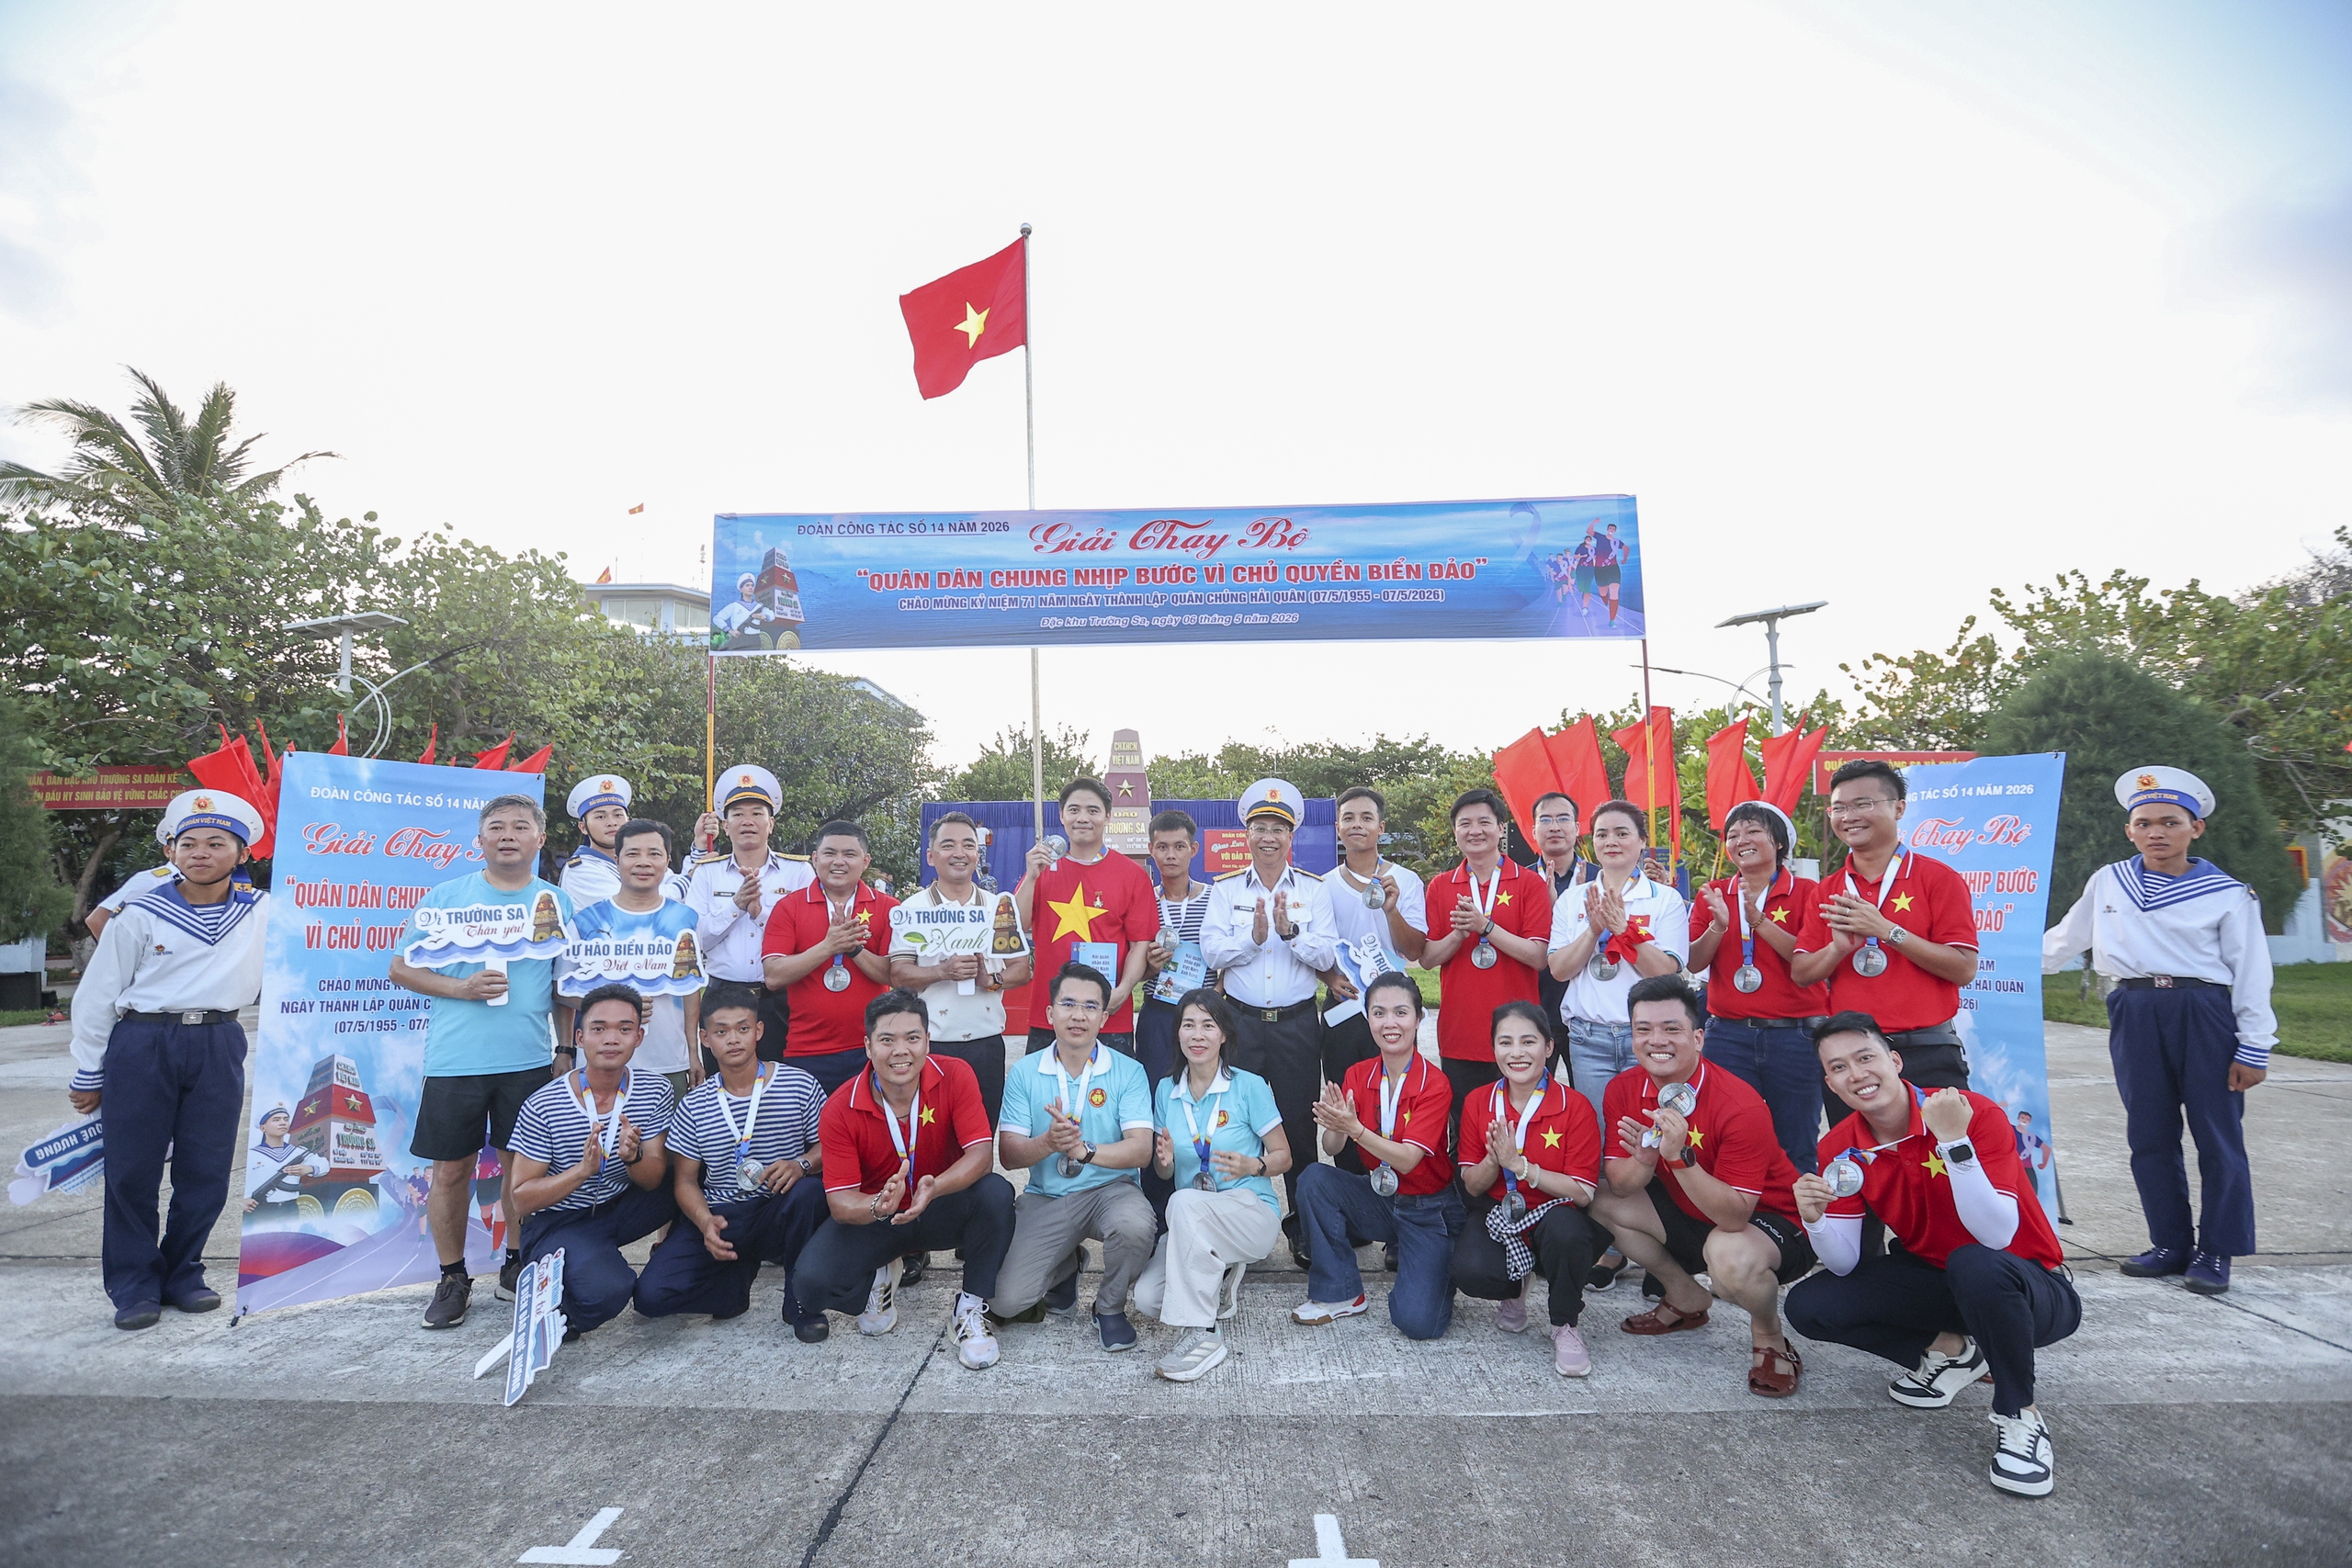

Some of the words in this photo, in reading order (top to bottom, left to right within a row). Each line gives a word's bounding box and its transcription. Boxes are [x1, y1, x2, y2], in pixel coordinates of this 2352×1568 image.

[797, 522, 833, 535] ĐOÀN
[838, 522, 874, 535] CÔNG
[878, 521, 904, 534] TÁC
[909, 519, 927, 533] SỐ
[931, 523, 944, 533] 14
[948, 521, 977, 533] NĂM
[980, 521, 1010, 533] 2026
[1029, 522, 1118, 554] Giải
[1128, 517, 1231, 561] Chạy
[1237, 516, 1309, 551] Bộ
[936, 568, 983, 589] DÂN
[989, 568, 1068, 588] CHUNG
[1073, 567, 1129, 589] NHỊP
[1136, 563, 1198, 586] BƯỚC
[1204, 561, 1226, 584] VÌ
[1232, 559, 1279, 583] CHỦ
[1285, 558, 1362, 582] QUYỀN
[1368, 558, 1423, 581] BIỂN
[899, 596, 930, 611] CHÀO
[933, 595, 967, 610] MỪNG
[970, 593, 986, 609] KỶ
[988, 594, 1019, 612] NIỆM
[1022, 596, 1035, 608] 71
[1039, 594, 1069, 608] NĂM
[1070, 593, 1102, 607] NGÀY
[1104, 592, 1143, 606] THÀNH
[1146, 592, 1167, 607] LẬP
[1170, 591, 1204, 605] QUÂN
[1206, 590, 1247, 604] CHỦNG
[1250, 589, 1270, 603] HẢI
[1272, 588, 1305, 603] QUÂN
[1309, 590, 1372, 604] (07/5/1955
[1382, 589, 1446, 602] 07/5/2026)
[1040, 616, 1063, 629] Đặc
[1065, 616, 1087, 626] khu
[1089, 615, 1129, 628] Trường
[1151, 615, 1181, 627] ngày
[1182, 614, 1197, 625] 06
[1199, 614, 1232, 626] tháng
[1234, 614, 1243, 624] 5
[1245, 614, 1269, 623] năm
[1271, 613, 1299, 623] 2026
[1114, 741, 1137, 751] CHXHCN
[1112, 753, 1125, 769] VIỆT
[1125, 754, 1140, 765] NAM
[100, 773, 130, 784] TRƯỜNG
[131, 773, 142, 784] SA
[144, 772, 165, 784] ĐOÀN
[167, 772, 182, 784] KẾ
[62, 791, 73, 801] HY
[74, 791, 94, 801] SINH
[96, 787, 111, 801] BẢO
[113, 788, 122, 803] VỆ
[125, 789, 145, 800] VỮNG
[148, 786, 168, 800] CHẮC
[311, 786, 349, 800] ĐOÀN
[354, 789, 392, 804] CÔNG
[396, 791, 422, 807] TÁC
[424, 793, 444, 808] SỐ
[446, 797, 460, 809] 14
[1920, 787, 1939, 801] TÁC
[1942, 784, 1959, 798] SỐ
[1961, 787, 1973, 797] 14
[1975, 783, 2003, 796] NĂM
[2006, 784, 2034, 795] 2026
[1114, 809, 1138, 818] ĐẢO
[1136, 822, 1146, 833] SA
[1911, 815, 1974, 855] Chạy
[1976, 814, 2032, 850] Bộ
[301, 822, 377, 855] Giải
[383, 827, 462, 870] Chạy
[1231, 851, 1243, 861] ĐẢO
[1996, 865, 2038, 894] BƯỚC
[346, 880, 383, 909] DÂN
[420, 911, 442, 927] Vì
[447, 908, 503, 924] TRƯỜNG
[506, 908, 525, 920] SA
[892, 909, 912, 926] Vì
[915, 908, 966, 924] TRƯỜNG
[969, 909, 985, 923] SA
[305, 919, 322, 950] VÌ
[326, 917, 362, 950] CHỦ
[463, 924, 498, 938] Thân
[503, 922, 526, 939] yêu!
[931, 926, 989, 953] Xanh
[584, 942, 610, 956] HÀO
[615, 939, 643, 955] BIỂN
[647, 940, 673, 955] ĐẢO
[604, 958, 628, 972] Việt
[634, 958, 667, 970] Nam
[318, 976, 351, 992] CHÀO
[355, 976, 391, 992] MỪNG
[1975, 976, 1992, 991] HẢI
[1995, 978, 2024, 994] QUÂN
[280, 998, 315, 1014] NGÀY
[319, 998, 359, 1013] THÀNH
[362, 997, 385, 1014] LẬP
[389, 996, 420, 1011] QUÂN
[334, 1019, 397, 1034] (07/5/1955
[80, 1123, 103, 1142] QUÊ
[35, 1134, 79, 1160] HƯƠNG
[521, 1273, 531, 1284] VÌ
[552, 1258, 560, 1284] HÀNH
